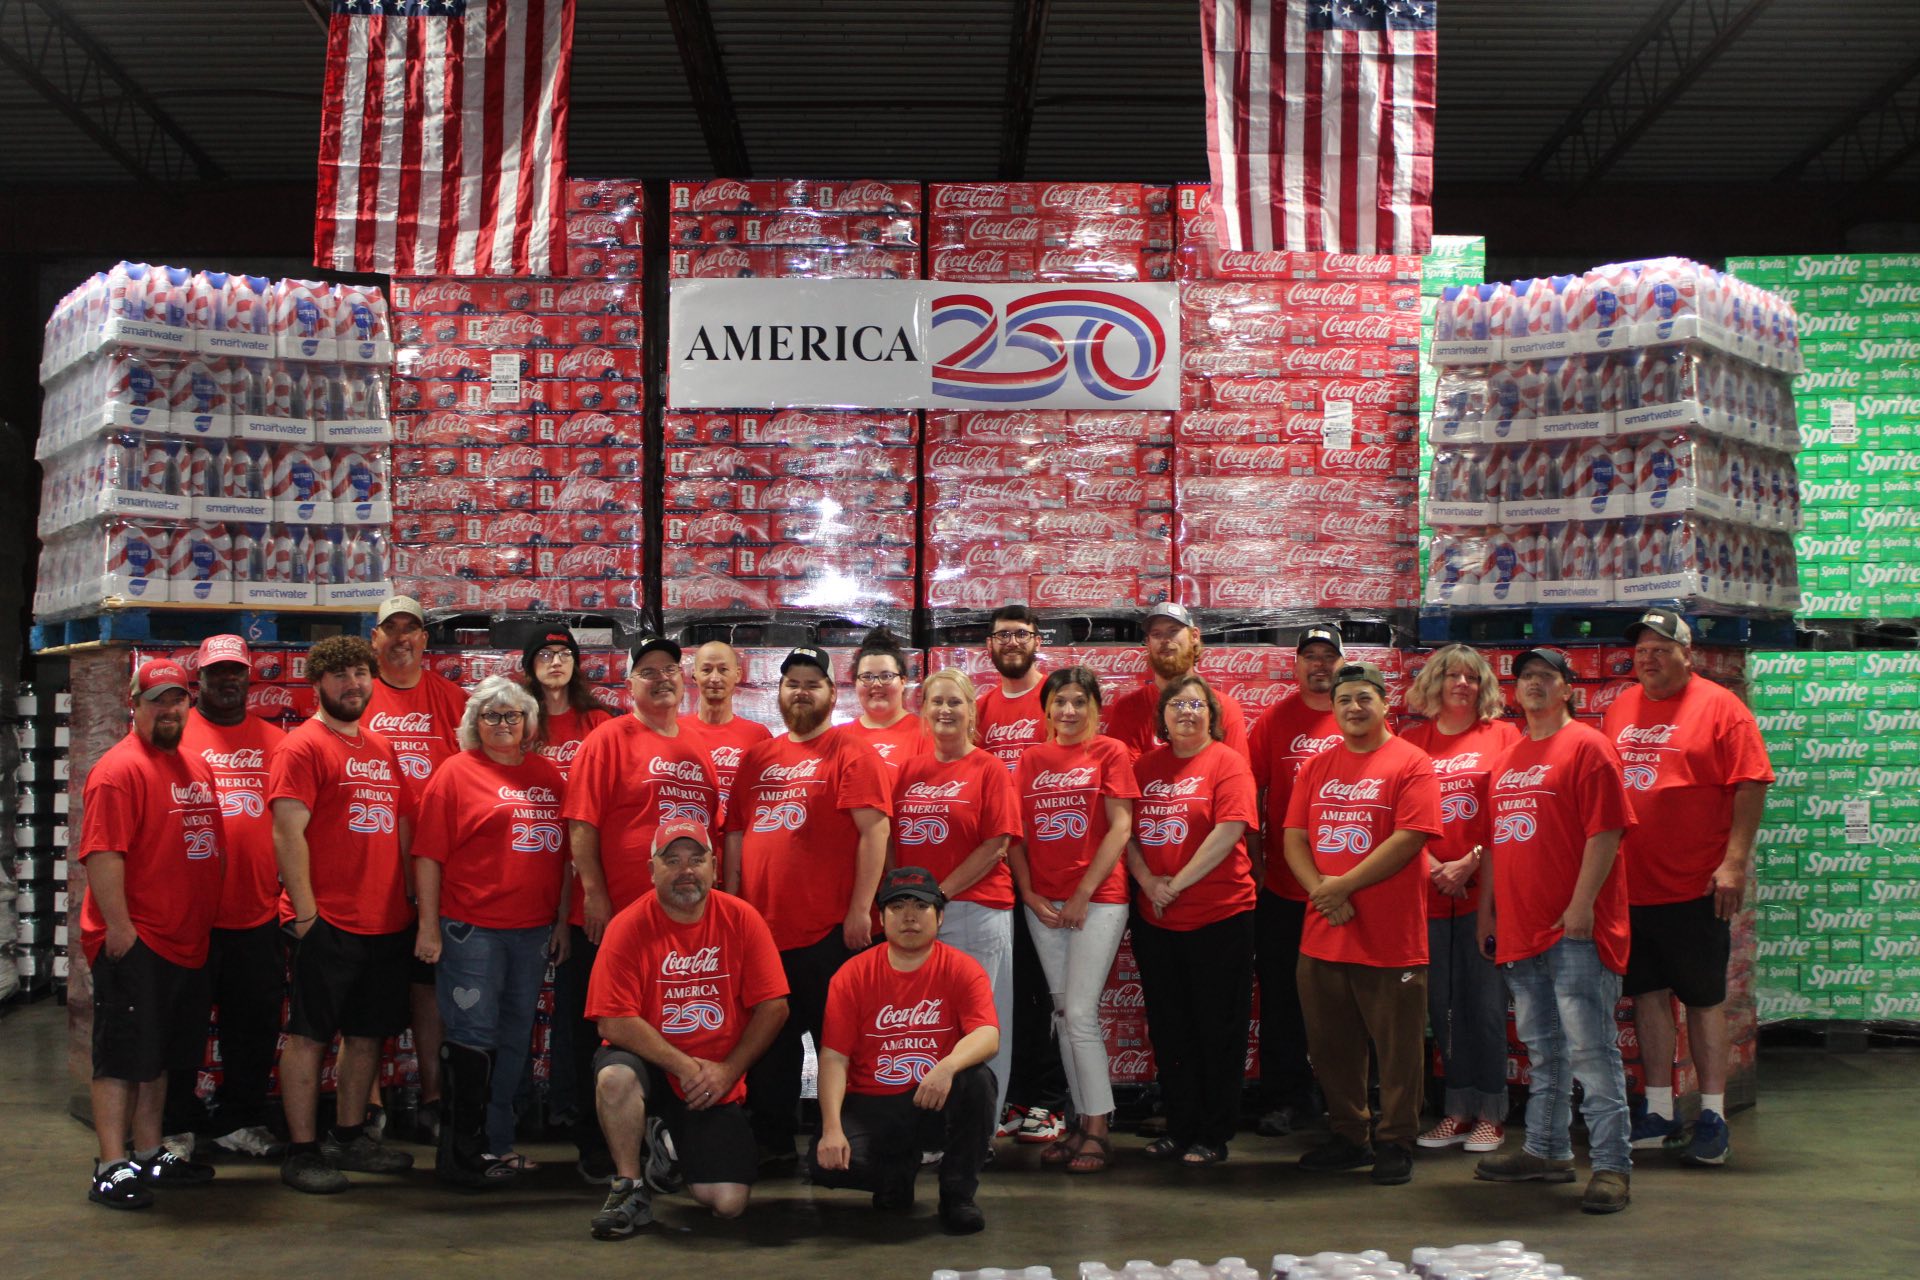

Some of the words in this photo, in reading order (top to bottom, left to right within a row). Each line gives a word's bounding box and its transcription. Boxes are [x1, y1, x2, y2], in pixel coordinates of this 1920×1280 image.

[936, 185, 1009, 208] Coca-Cola
[1042, 184, 1113, 209] Coca-Cola
[969, 217, 1042, 241] Coca-Cola
[934, 250, 1008, 273] Coca-Cola
[1218, 251, 1292, 273] Coca-Cola
[1322, 254, 1395, 273] Coca-Cola
[1727, 260, 1755, 271] Sprite
[1758, 259, 1786, 269] Sprite
[1795, 255, 1861, 280] Sprite
[1287, 282, 1360, 306] Coca-Cola
[1820, 286, 1848, 296] Sprite
[1856, 282, 1920, 307] Sprite
[122, 324, 184, 342] smartwater
[1322, 315, 1394, 339] Coca-Cola
[1798, 311, 1861, 336] Sprite
[210, 336, 269, 351] smartwater
[685, 325, 919, 362] AMERICA
[931, 289, 1166, 401] 250
[1436, 344, 1488, 356] smartwater
[1510, 340, 1566, 354] smartwater
[1819, 343, 1848, 352] Sprite
[1855, 338, 1920, 363] Sprite
[1286, 347, 1359, 371] Coca-Cola
[1217, 379, 1290, 403] Coca-Cola
[1795, 367, 1861, 392] Sprite
[1624, 407, 1683, 425] smartwater
[1857, 395, 1920, 419] Sprite
[250, 421, 307, 436] smartwater
[328, 424, 383, 437] smartwater
[967, 412, 1041, 437] Coca-Cola
[1180, 413, 1253, 436] Coca-Cola
[1543, 419, 1600, 432] smartwater
[929, 446, 1001, 469] Coca-Cola
[1216, 446, 1290, 470] Coca-Cola
[1321, 447, 1395, 470] Coca-Cola
[1820, 454, 1849, 464] Sprite
[1857, 451, 1920, 475] Sprite
[1074, 478, 1145, 502] Coca-Cola
[1799, 480, 1862, 504] Sprite
[1883, 482, 1911, 492] Sprite
[118, 495, 180, 511] smartwater
[206, 503, 266, 515] smartwater
[1432, 506, 1484, 516] smartwater
[1505, 505, 1561, 517] smartwater
[1321, 511, 1394, 536] Coca-Cola
[1796, 535, 1862, 560] Sprite
[1821, 567, 1849, 576] Sprite
[1857, 562, 1920, 587] Sprite
[250, 588, 307, 600] smartwater
[330, 587, 386, 599] smartwater
[1036, 576, 1109, 600] Coca-Cola
[1542, 585, 1598, 597] smartwater
[1623, 578, 1682, 593] smartwater
[1797, 591, 1862, 616] Sprite
[1751, 653, 1807, 678] prite
[1827, 656, 1856, 667] Sprite
[1765, 685, 1793, 694] Sprite
[1802, 682, 1868, 707] Sprite
[369, 711, 432, 732] Coca-Cola
[985, 718, 1041, 743] Coca-Cola
[1617, 724, 1679, 743] Coca-Cola
[393, 741, 429, 751] ERICA
[994, 748, 1023, 759] MERIC
[1621, 752, 1661, 762] MERICA
[1802, 738, 1869, 763] Sprite
[346, 757, 392, 781] Coca-Cola
[649, 756, 704, 782] Coca-Cola
[760, 758, 822, 781] Coca-Cola
[1432, 752, 1482, 773] ca-Cola
[215, 777, 263, 788] MERICA
[1032, 767, 1097, 790] Coca-Cola
[1143, 776, 1205, 798] Coca-Cola
[1440, 778, 1475, 792] ERICA
[1496, 765, 1553, 789] Coca-Cola
[353, 788, 393, 802] AMERICA
[498, 786, 556, 802] Coca-Cola
[659, 786, 706, 802] AMERICA
[758, 787, 807, 801] AMERICA
[905, 780, 968, 799] Coca-Cola
[1319, 778, 1385, 800] Coca-Cola
[900, 804, 949, 813] AMERICA
[1035, 795, 1086, 809] AMERICA
[1141, 804, 1189, 815] AMERICA
[348, 803, 394, 834] 250
[753, 801, 807, 832] 250
[1035, 809, 1088, 841] 250
[1320, 811, 1372, 822] AMERICA
[512, 823, 562, 852] 250
[899, 815, 949, 845] 250
[1139, 816, 1188, 846] 250
[1316, 824, 1372, 854] 250
[1756, 824, 1808, 844] prite
[1805, 851, 1872, 876] Sprite
[1806, 908, 1873, 933] Sprite
[662, 946, 721, 976] Coca-Cola
[1807, 964, 1875, 989] Sprite
[664, 984, 719, 999] AMERICA
[662, 1000, 724, 1034] 250
[876, 999, 943, 1030] Coca-Cola
[880, 1037, 938, 1051] AMERICA
